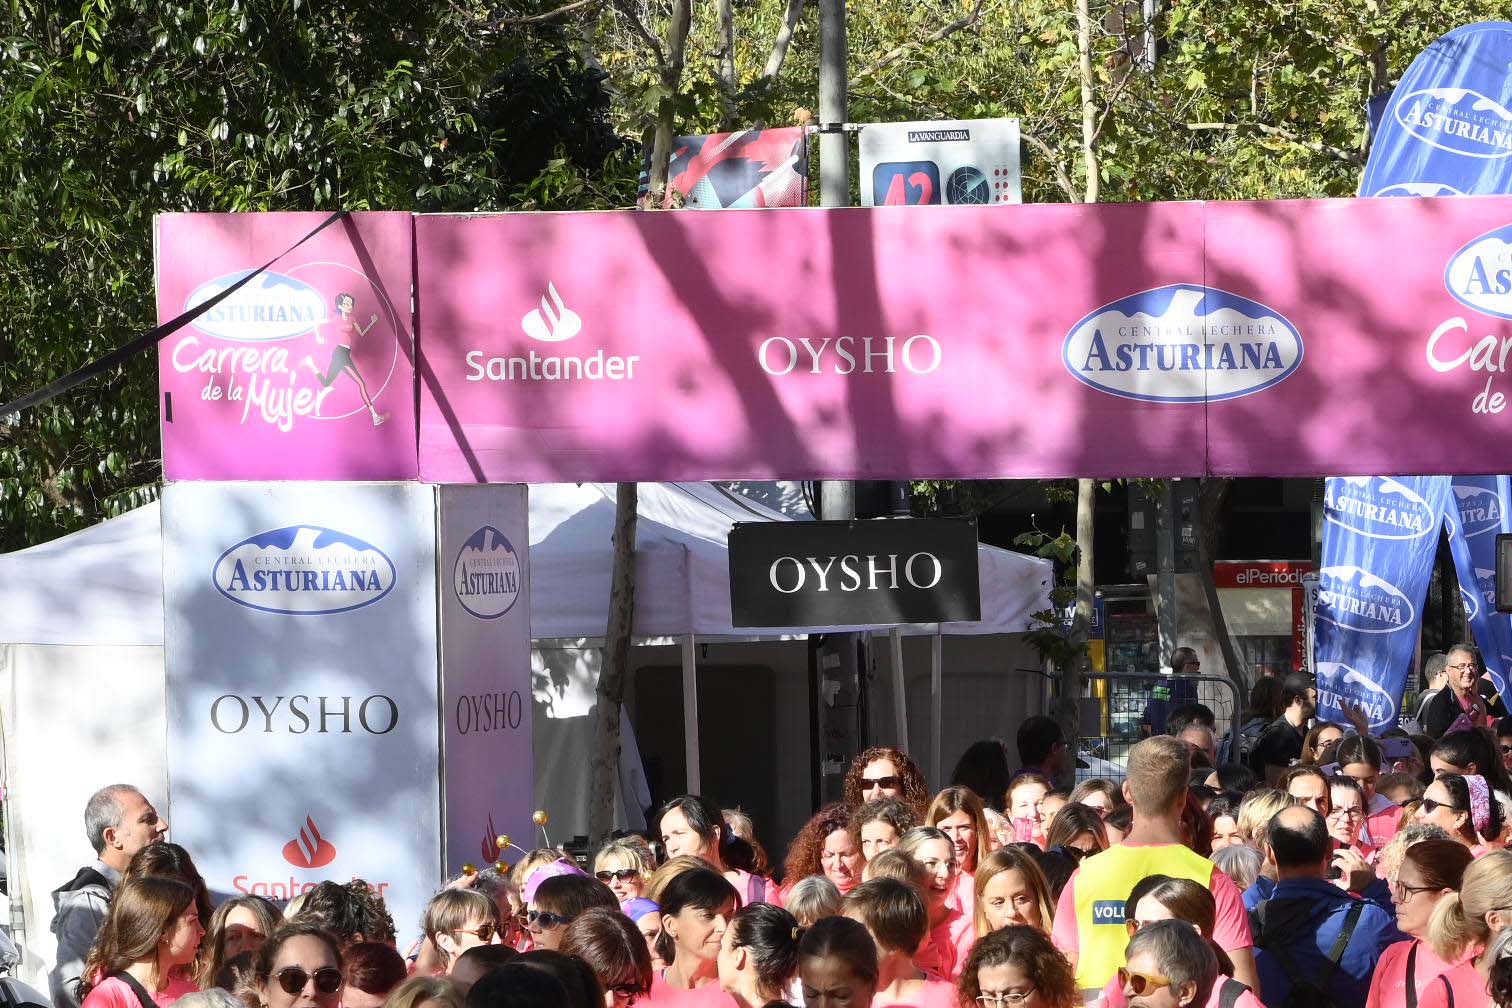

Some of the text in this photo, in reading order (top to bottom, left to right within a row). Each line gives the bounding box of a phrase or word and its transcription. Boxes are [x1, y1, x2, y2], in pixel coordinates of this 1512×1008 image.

[1081, 328, 1283, 371] ASTURIANA
[1119, 325, 1178, 337] CENTRAL
[172, 335, 289, 374] Carrera
[466, 349, 640, 382] Santander
[758, 334, 942, 376] OYSHO
[201, 374, 243, 402] de la
[240, 371, 336, 433] Mujer
[1472, 376, 1506, 414] de
[1324, 487, 1424, 531] ASTURIANA
[227, 559, 384, 592] ASTURIANA
[255, 556, 313, 565] CENTRAL
[459, 561, 517, 596] ASTURIANA
[769, 552, 942, 594] OYSHO
[210, 695, 399, 734] OYSHO
[456, 690, 522, 735] OYSHO
